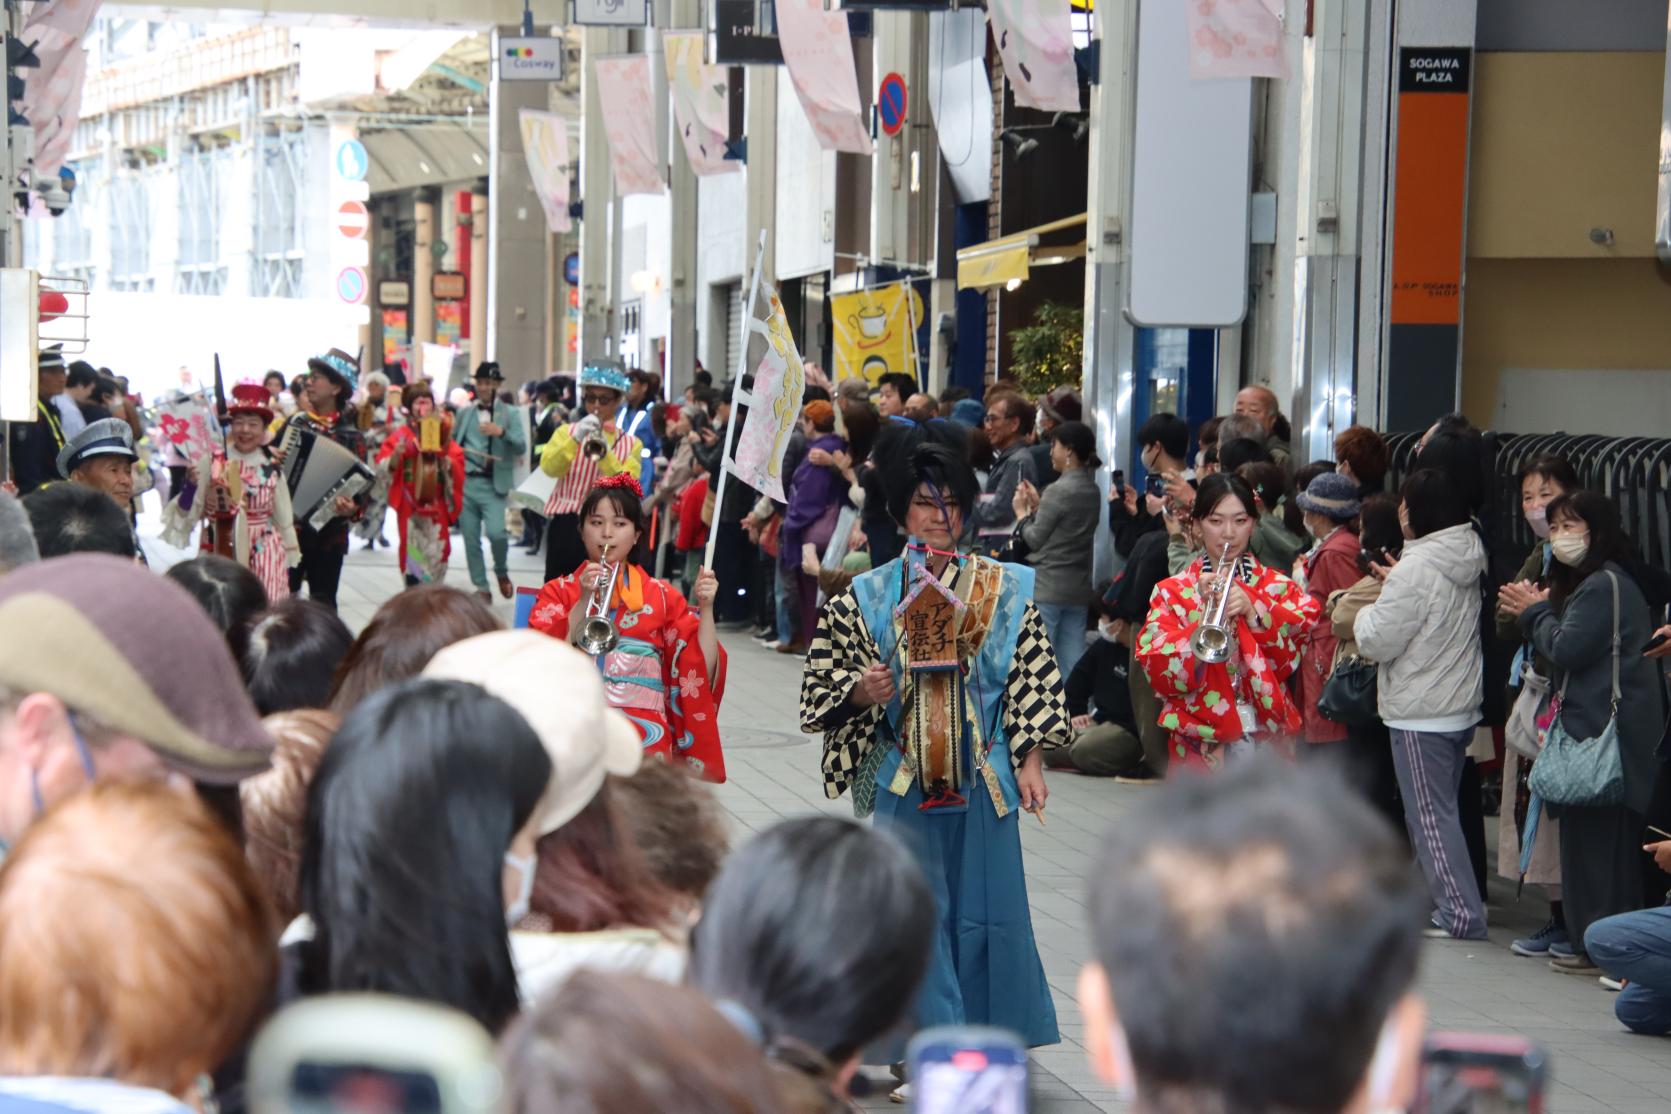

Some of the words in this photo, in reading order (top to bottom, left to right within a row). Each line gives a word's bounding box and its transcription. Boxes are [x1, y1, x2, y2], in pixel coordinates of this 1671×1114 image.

[513, 58, 555, 70] Cosway
[1409, 58, 1460, 69] SOGAWA
[1415, 71, 1453, 82] PLAZA
[930, 601, 953, 652] アダチ
[910, 609, 931, 662] 宣伝社
